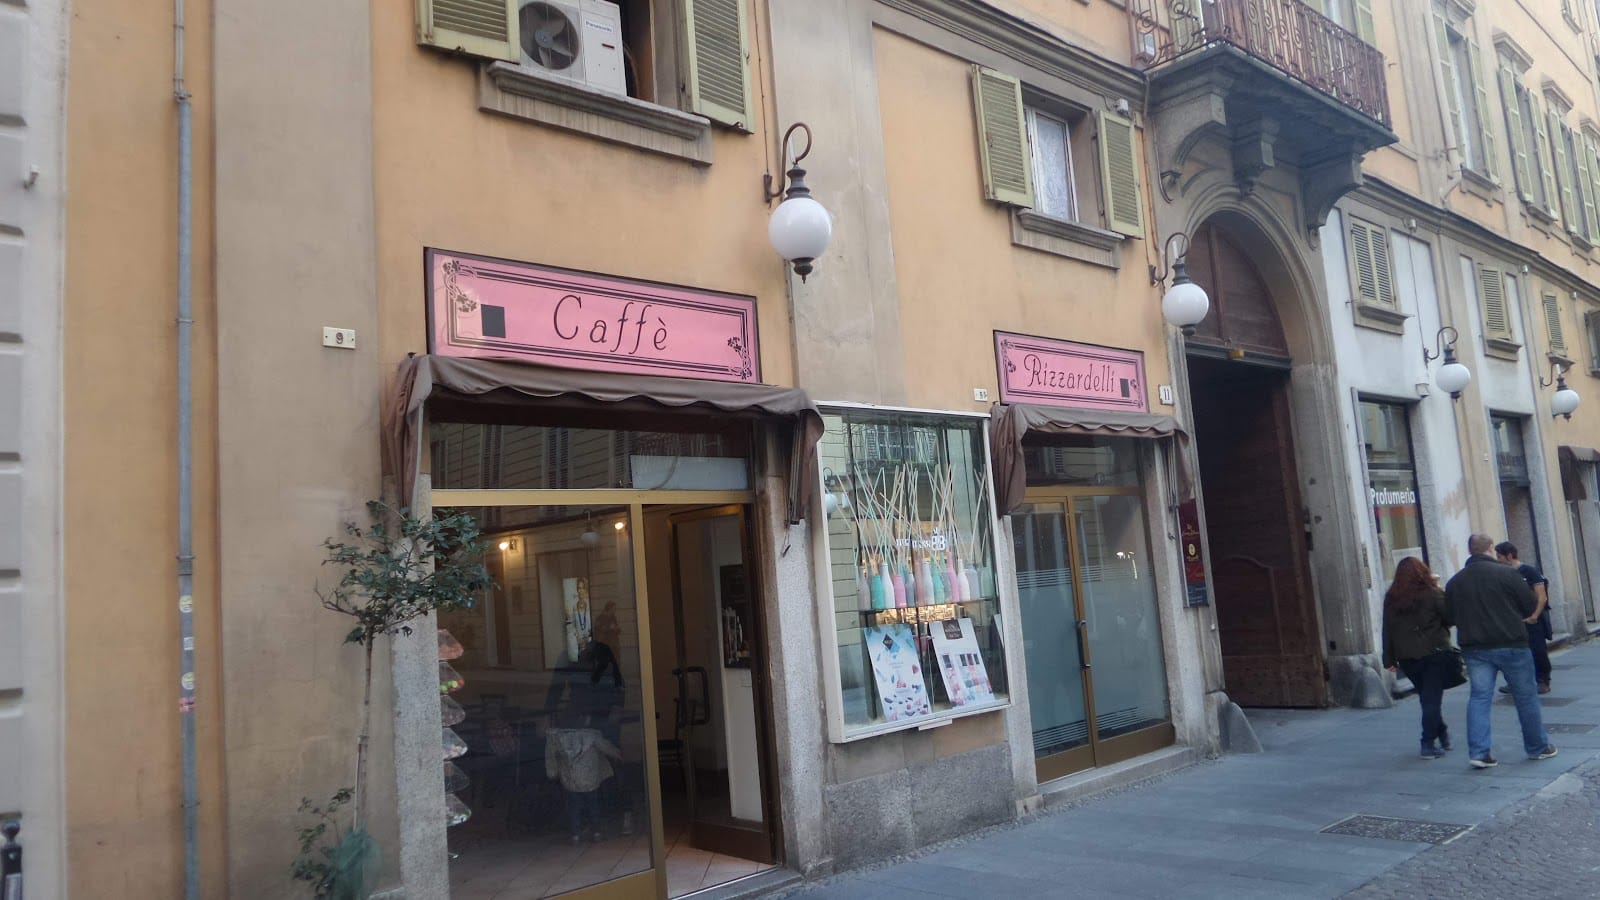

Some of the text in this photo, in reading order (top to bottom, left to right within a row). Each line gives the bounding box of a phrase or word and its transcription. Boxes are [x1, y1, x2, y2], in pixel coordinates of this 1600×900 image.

[553, 295, 667, 355] Caffè
[335, 332, 344, 345] 9
[1023, 353, 1115, 393] Rizzardelli
[1162, 387, 1170, 401] 11
[1369, 486, 1416, 505] Profumeria
